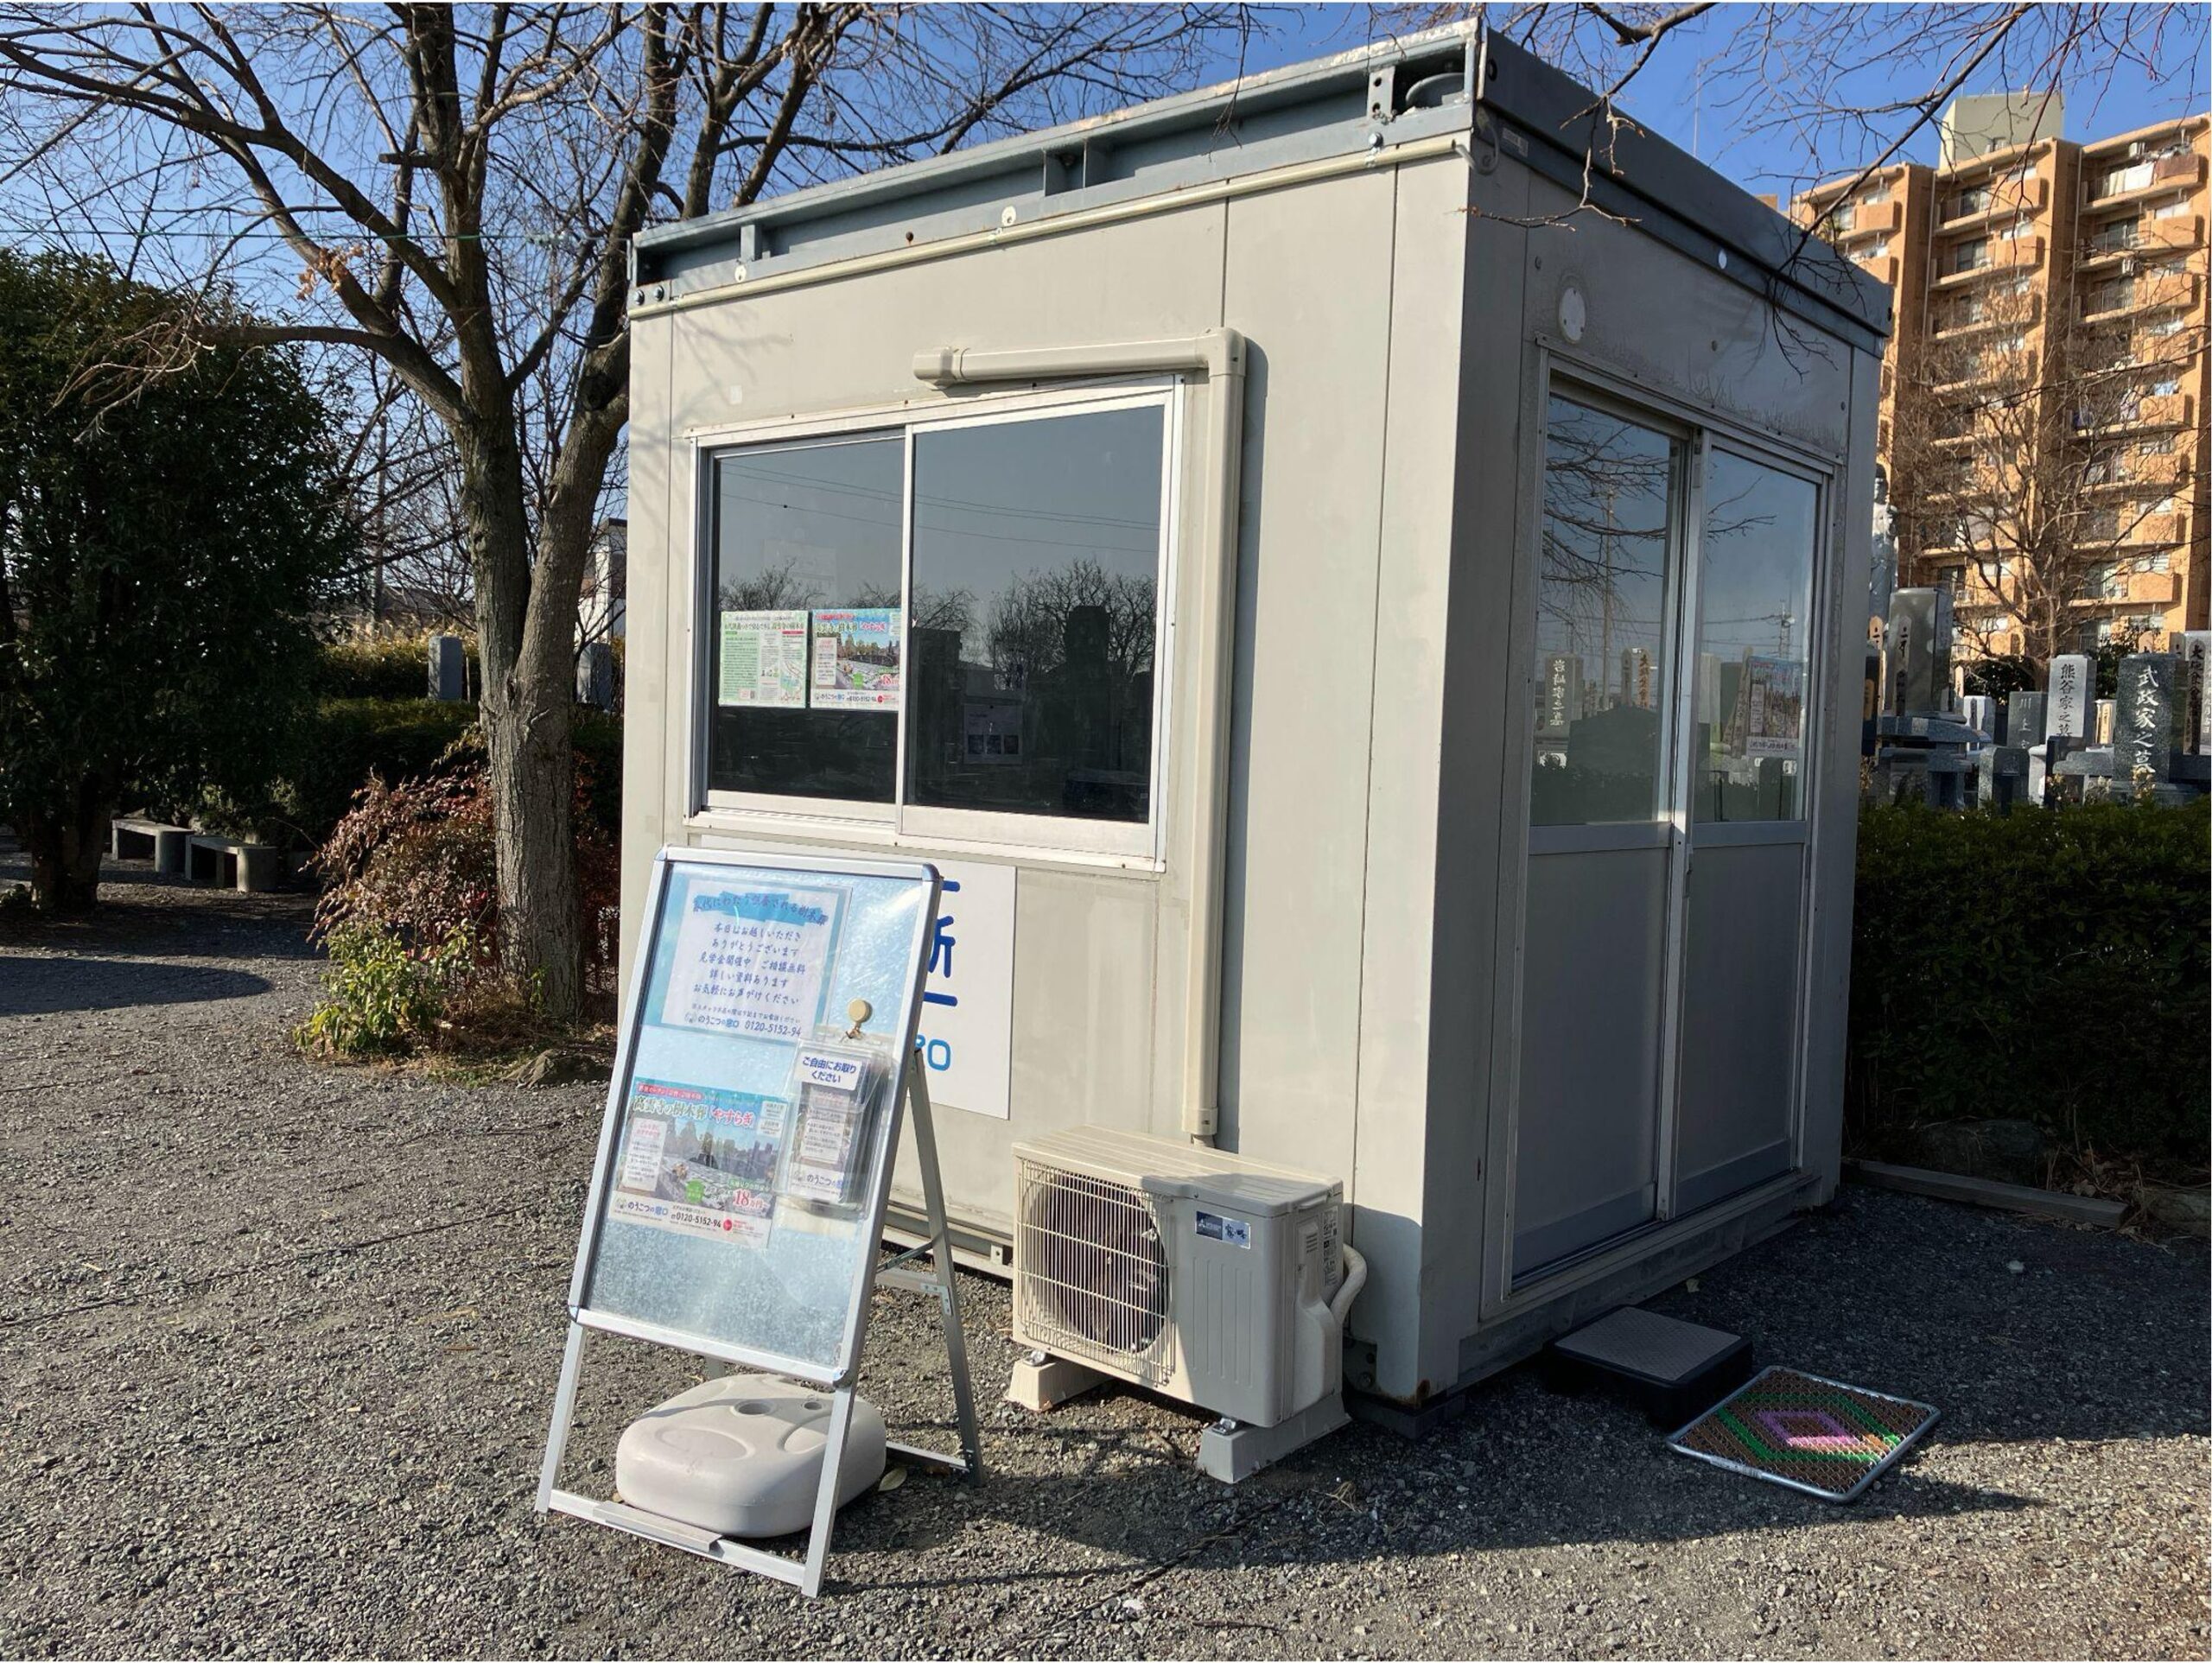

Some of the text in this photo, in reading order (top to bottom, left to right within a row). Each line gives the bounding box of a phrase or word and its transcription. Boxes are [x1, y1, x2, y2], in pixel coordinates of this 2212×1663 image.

[714, 923, 802, 943] 本日はお越しいただき
[712, 938, 799, 957] ありがとうございます
[698, 951, 806, 975] 見学会開催中 ご相談無料
[709, 968, 790, 988] 詳しい資料あります
[693, 983, 800, 1006] お気軽にお声がけください
[697, 1015, 802, 1038] のうこつの窓口 0120-5152-94
[802, 1056, 857, 1075] ご自由にお取り
[811, 1070, 842, 1083] ください
[627, 1201, 669, 1217] のうこつの窓口
[676, 1211, 722, 1228] 0120-5152-94
